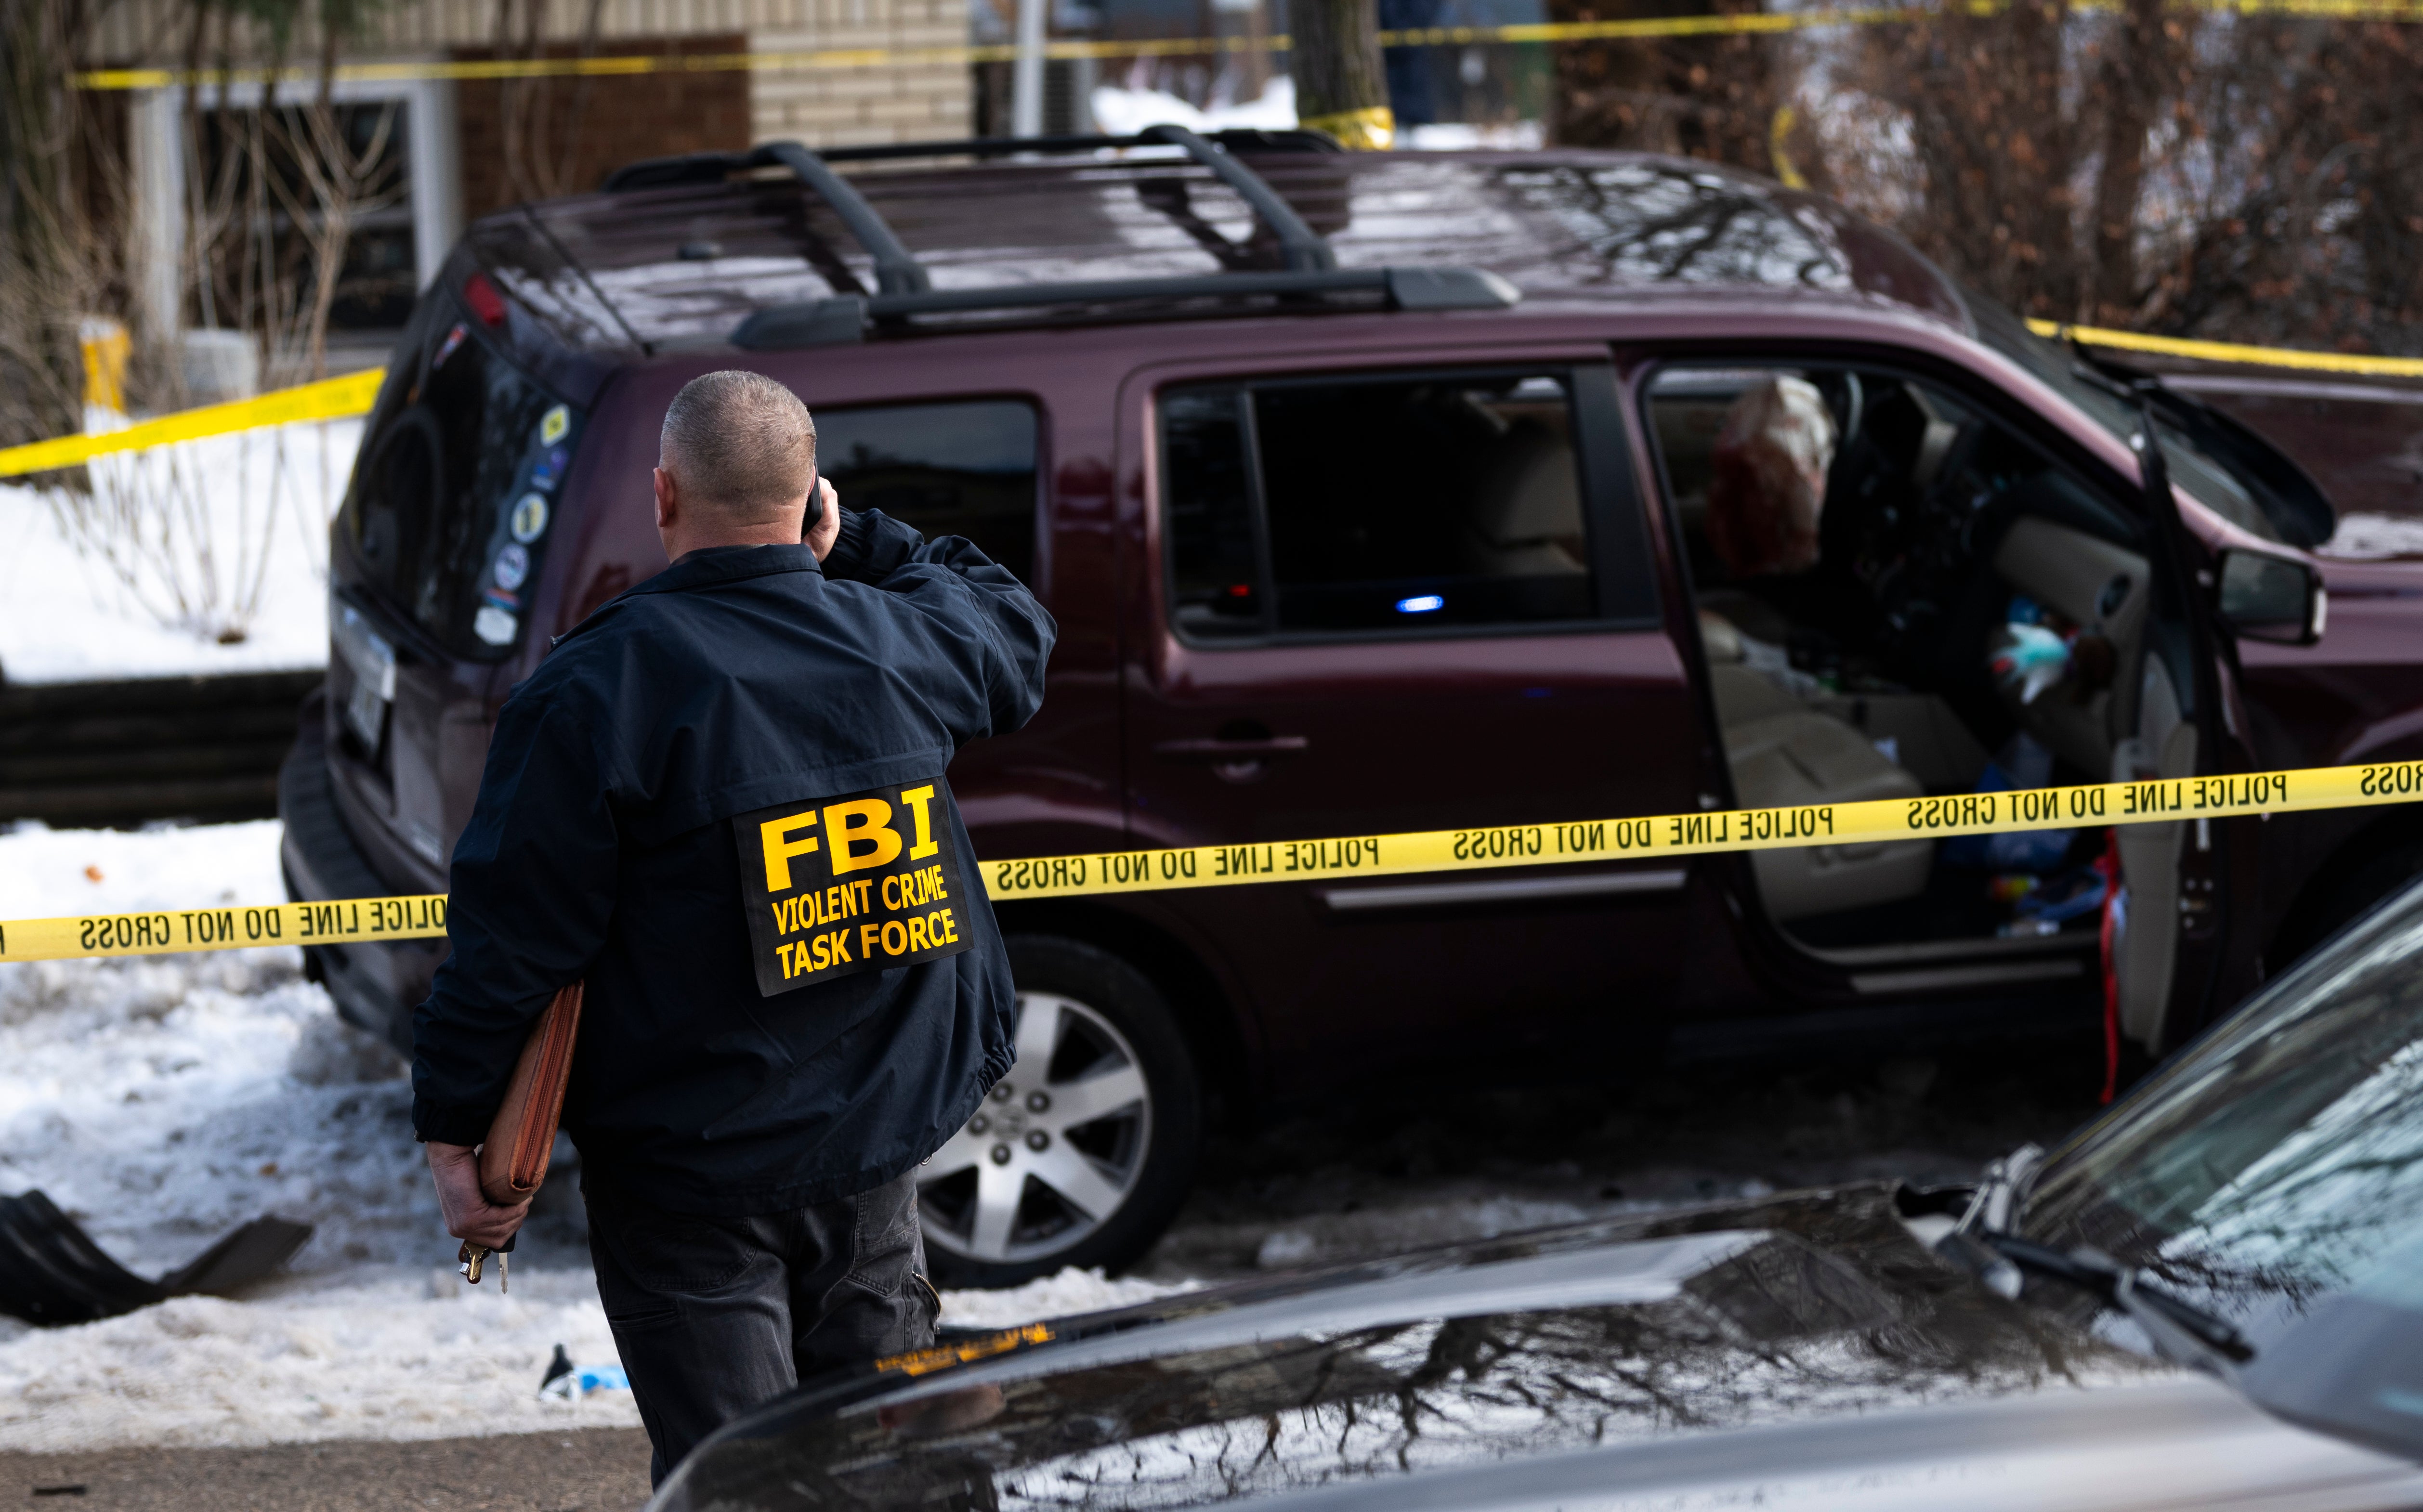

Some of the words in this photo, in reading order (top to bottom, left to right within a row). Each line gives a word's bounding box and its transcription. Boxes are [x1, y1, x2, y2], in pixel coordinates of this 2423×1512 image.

[760, 784, 939, 893] FBI
[771, 879, 872, 936] VIOLENT
[881, 864, 948, 911] CRIME
[776, 928, 852, 979] TASK
[860, 908, 959, 959] FORCE
